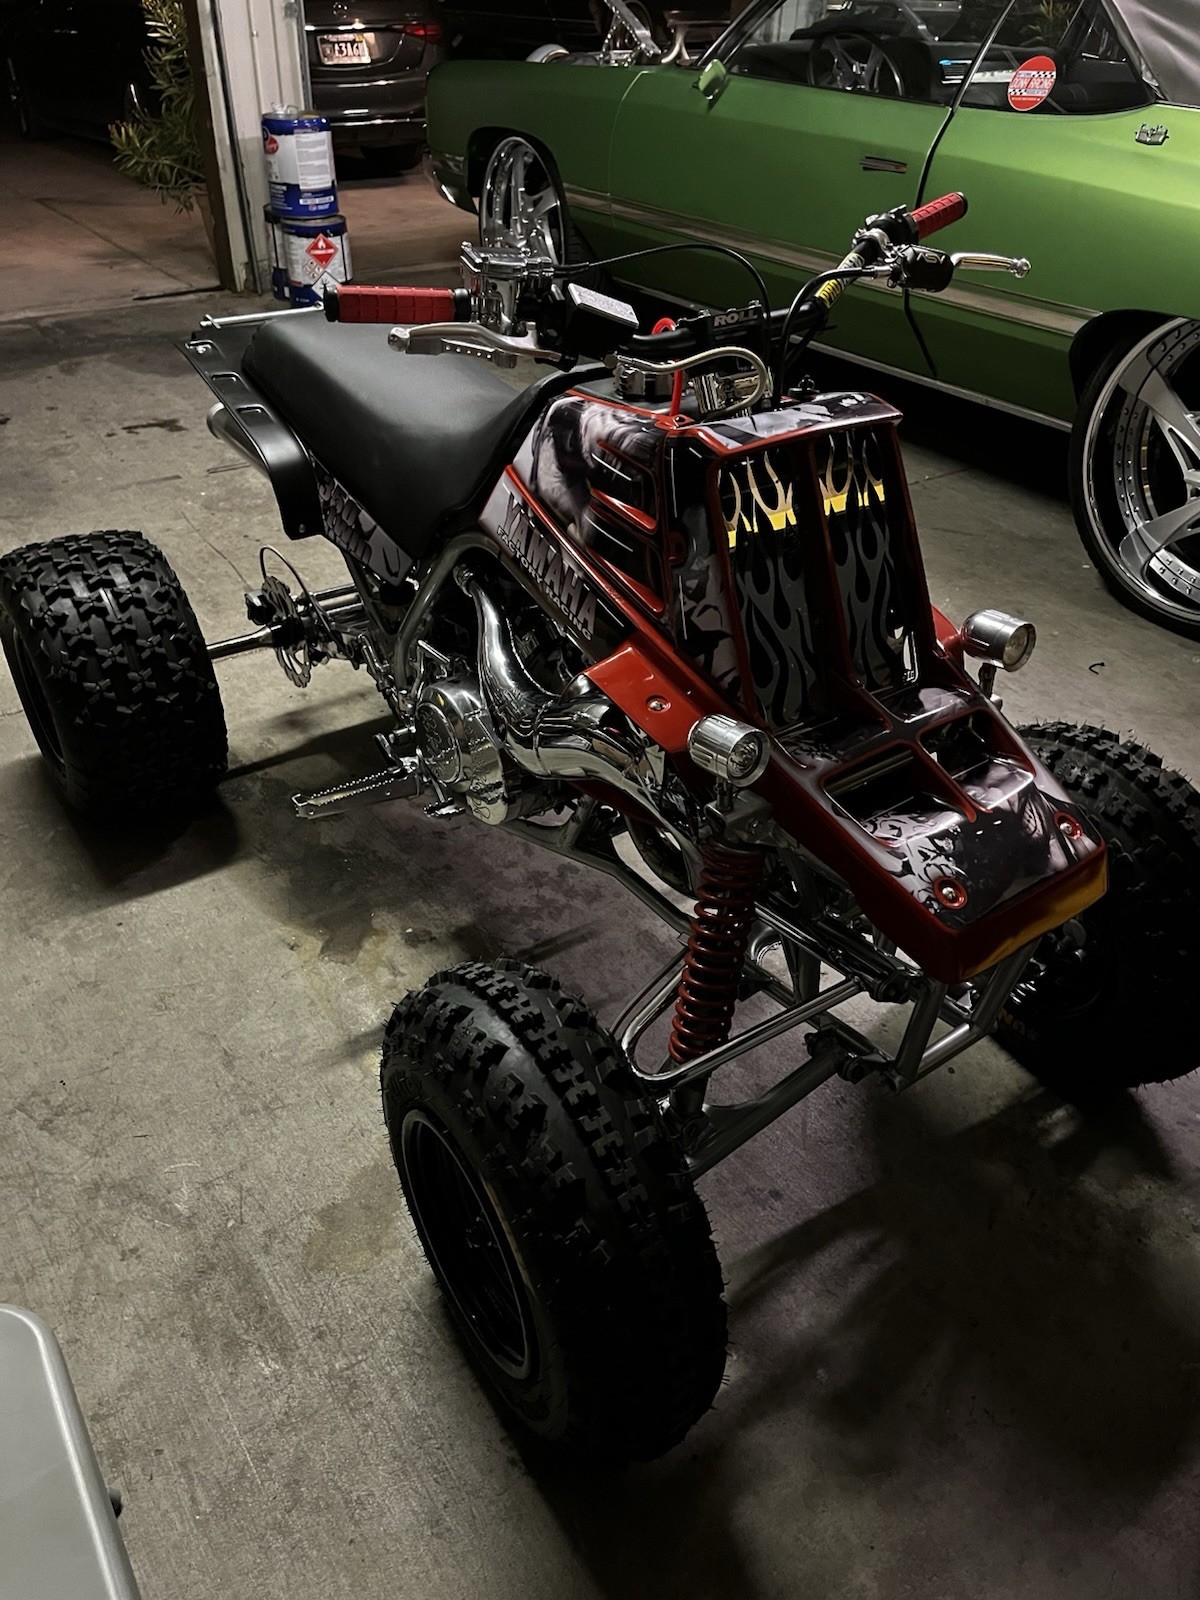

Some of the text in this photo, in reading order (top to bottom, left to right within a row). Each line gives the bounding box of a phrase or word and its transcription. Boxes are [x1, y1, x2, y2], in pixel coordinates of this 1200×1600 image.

[916, 252, 945, 264] ASV
[713, 309, 758, 328] ROLL
[496, 525, 593, 641] FACTORY RACING
[503, 491, 598, 635] YAMAHA
